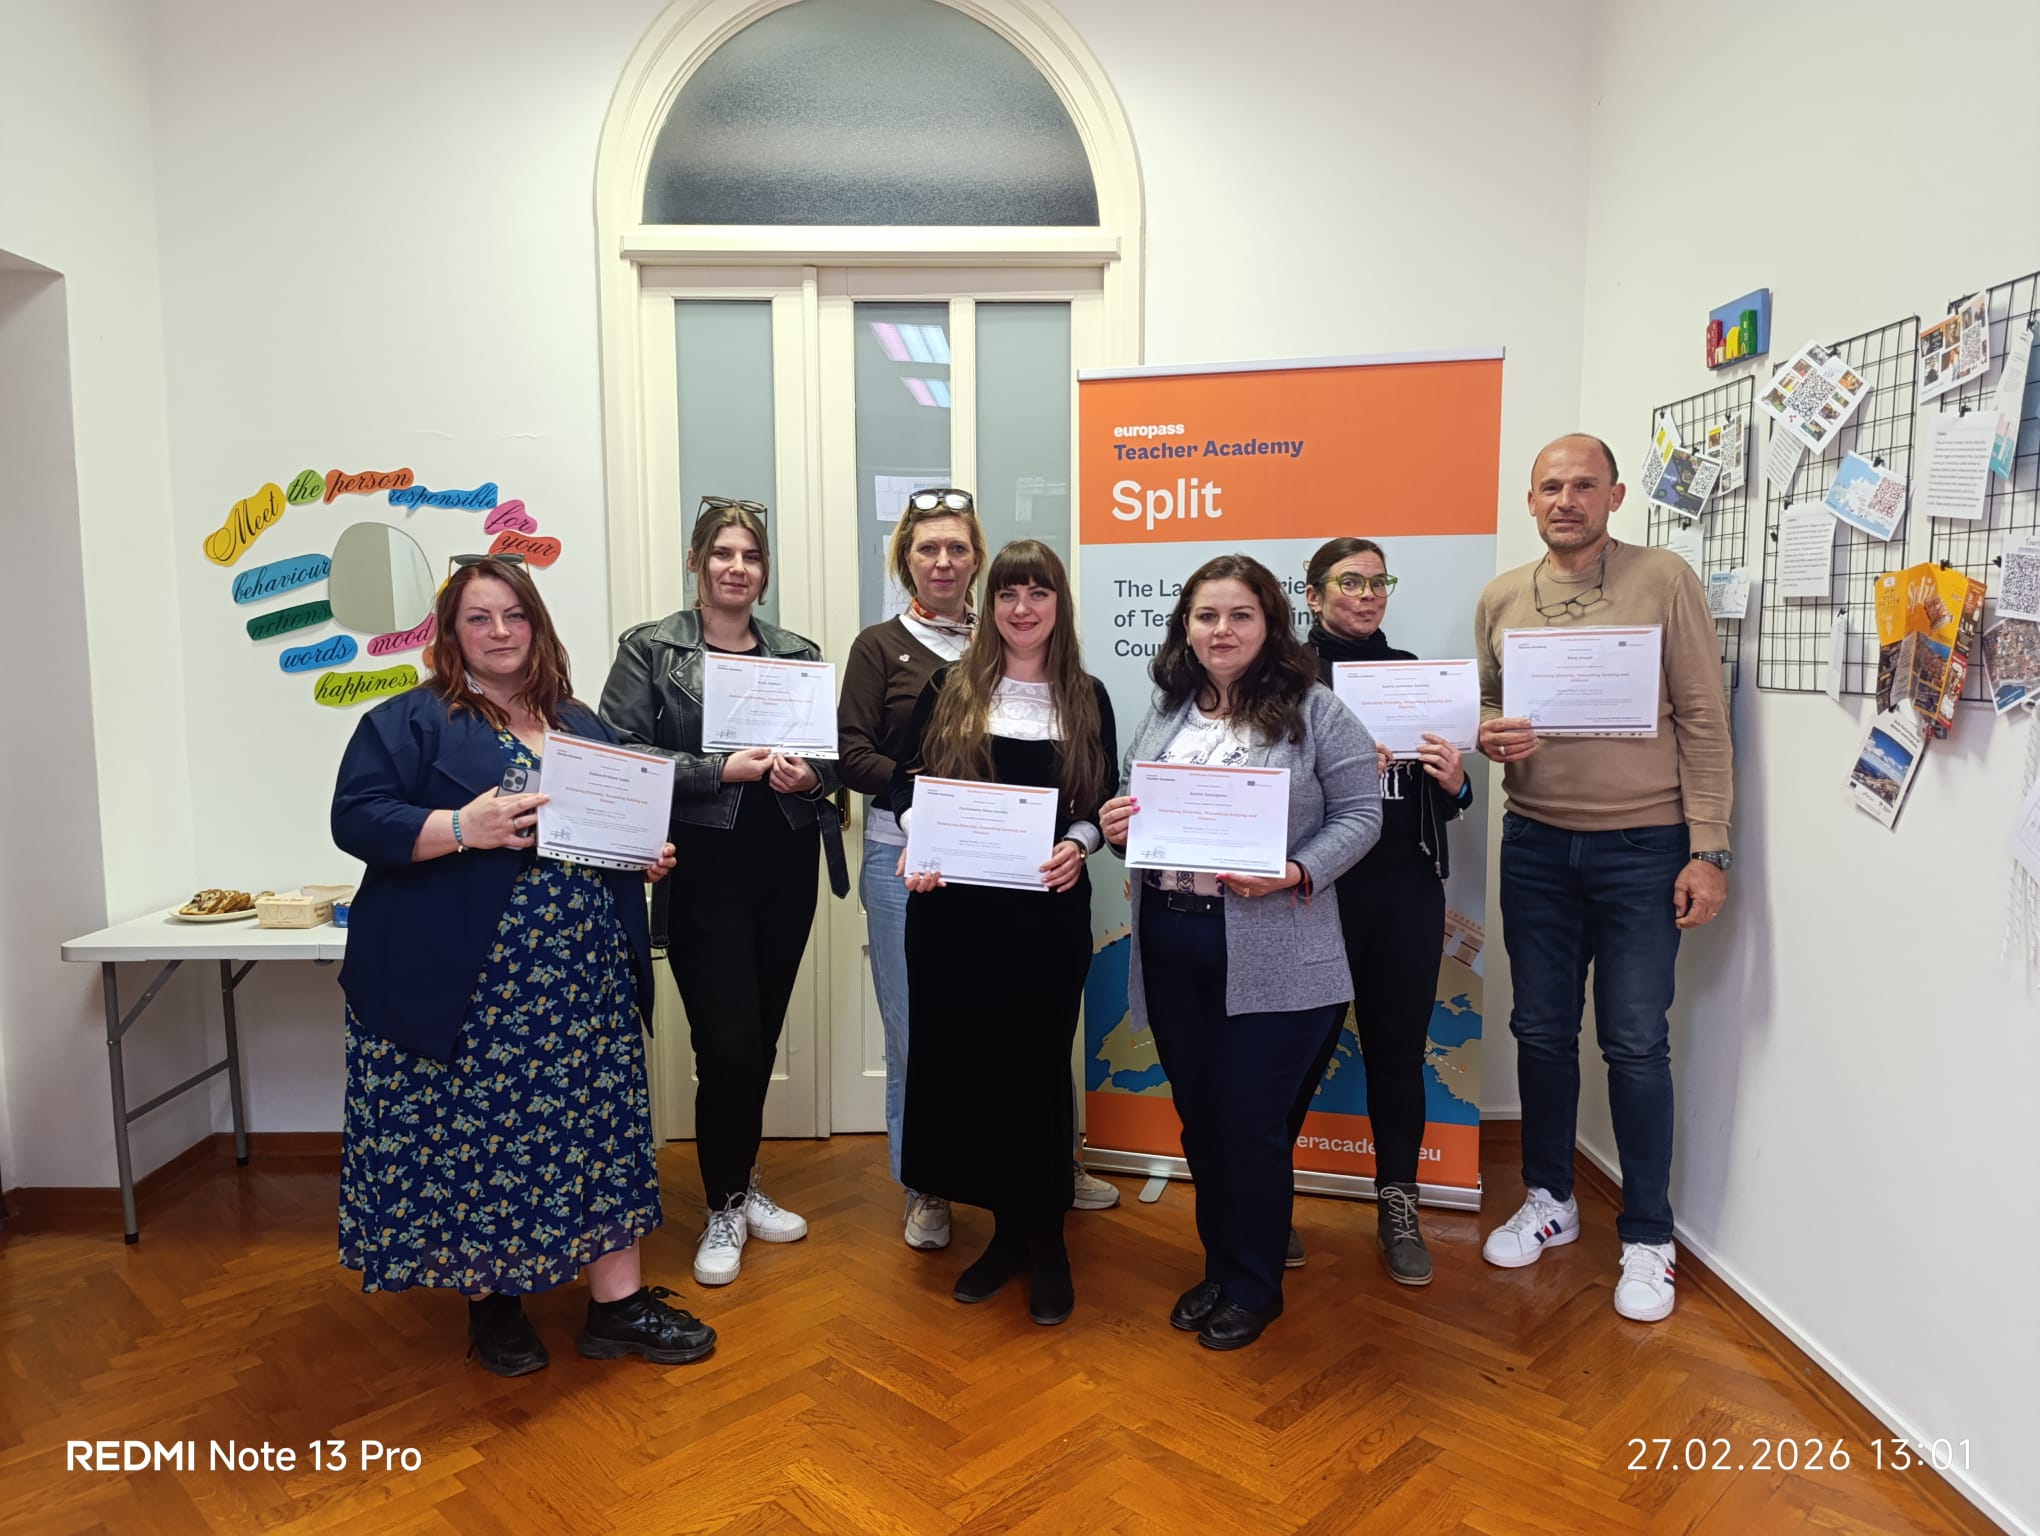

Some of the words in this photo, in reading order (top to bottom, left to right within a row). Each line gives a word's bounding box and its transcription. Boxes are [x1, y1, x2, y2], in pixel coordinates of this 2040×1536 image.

[1113, 423, 1185, 439] europass
[1113, 442, 1198, 461] Teacher
[1202, 438, 1304, 459] Academy
[287, 470, 324, 502] the
[326, 472, 410, 503] person
[389, 484, 498, 509] responsible
[485, 503, 532, 532] for
[1111, 477, 1223, 531] Split
[205, 490, 279, 562] Meet
[498, 535, 554, 557] your
[233, 560, 331, 603] behaviour
[1113, 579, 1153, 598] The
[251, 605, 328, 639] actions
[1113, 609, 1136, 627] of
[371, 617, 435, 654] mood
[284, 635, 353, 668] words
[315, 670, 420, 704] happiness
